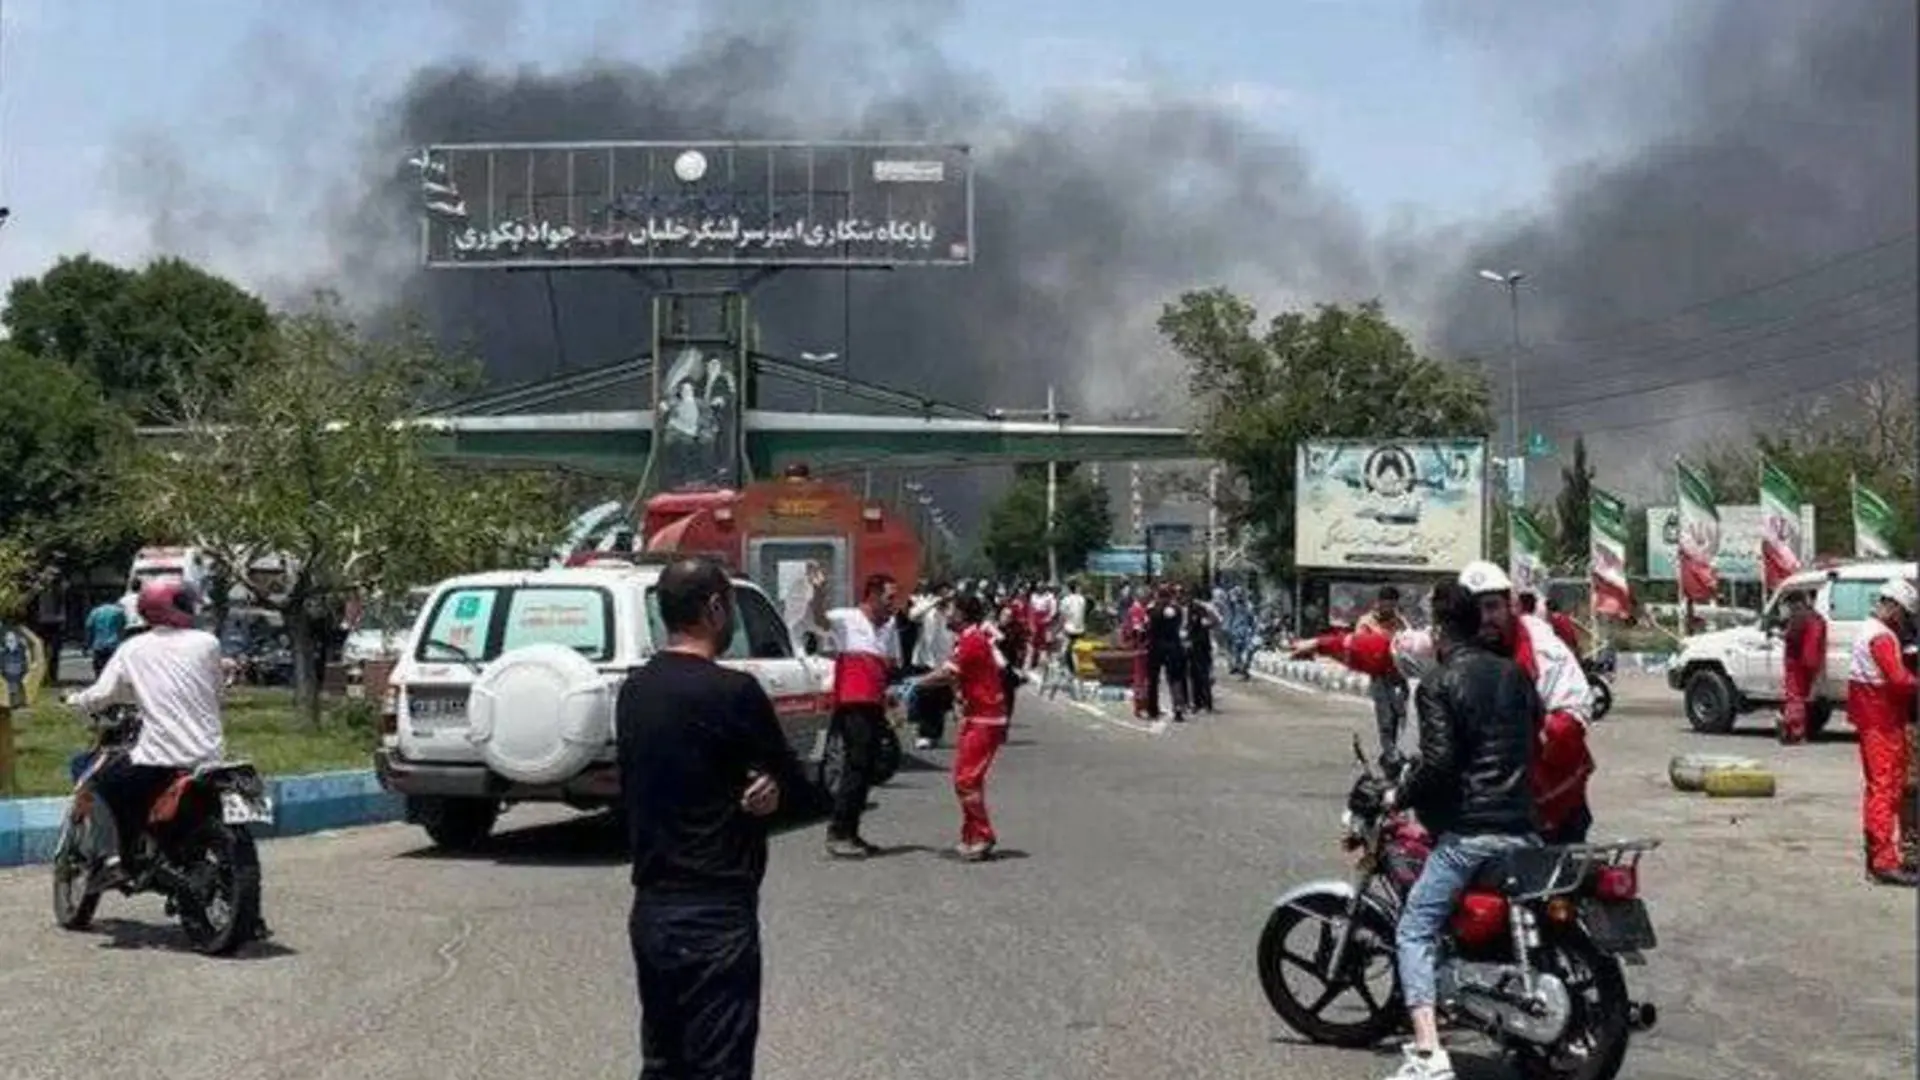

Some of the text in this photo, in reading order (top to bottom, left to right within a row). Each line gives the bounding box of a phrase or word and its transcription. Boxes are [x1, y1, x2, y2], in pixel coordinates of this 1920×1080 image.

[454, 219, 525, 257] فکوری
[527, 220, 575, 250] جواد
[627, 217, 690, 247] خلبان
[763, 219, 803, 248] امیر
[803, 218, 874, 247] شکاری
[876, 218, 934, 249] پایگاه
